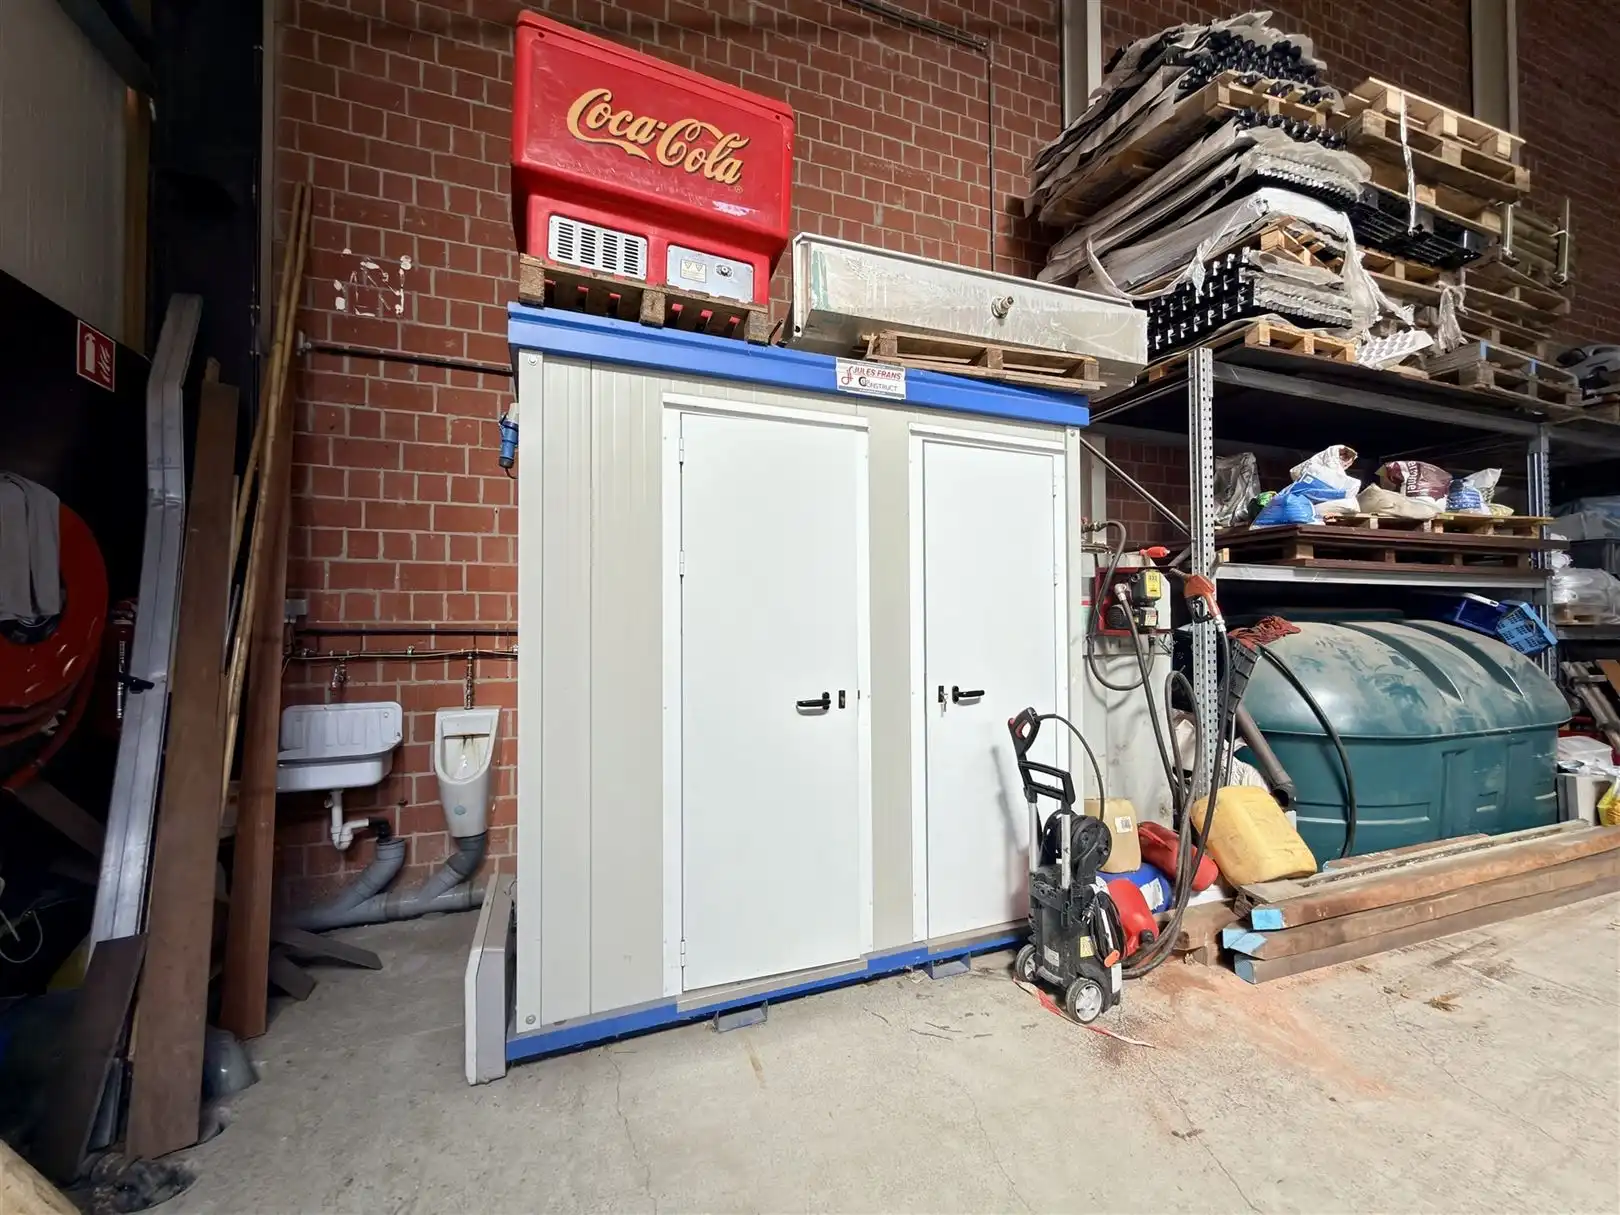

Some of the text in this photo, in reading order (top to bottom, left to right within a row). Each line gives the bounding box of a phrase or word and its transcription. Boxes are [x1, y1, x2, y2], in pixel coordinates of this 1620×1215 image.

[566, 88, 749, 185] Coca-Cola
[853, 366, 876, 377] JULES
[876, 370, 902, 381] FRANS
